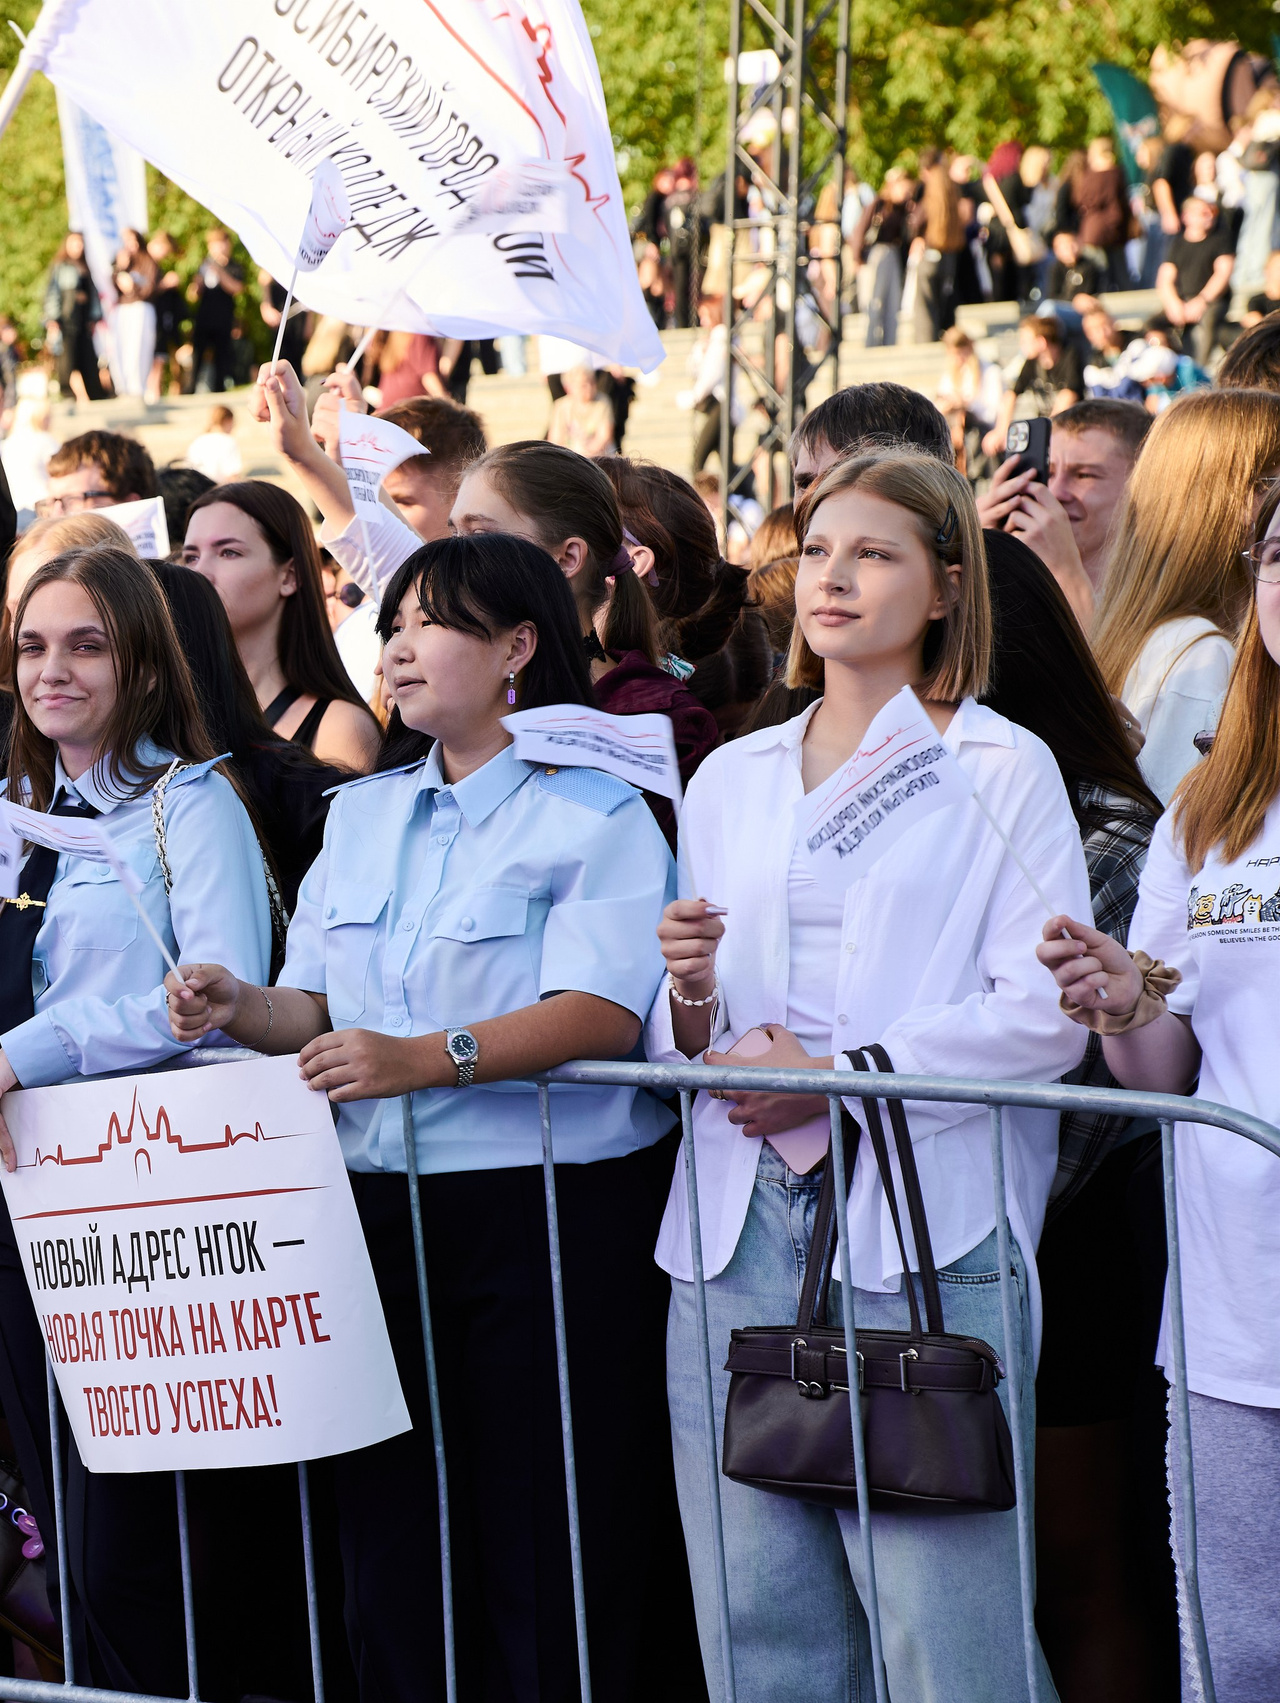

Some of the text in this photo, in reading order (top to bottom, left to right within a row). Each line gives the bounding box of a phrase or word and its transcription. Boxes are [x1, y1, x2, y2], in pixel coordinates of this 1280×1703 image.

[217, 36, 363, 170] ОТКРЫТЫЙ
[1246, 857, 1280, 867] HAP
[1219, 936, 1246, 944] BELIEVES
[1239, 927, 1261, 935] SMILES
[30, 1222, 105, 1290] НОВЫЙ
[112, 1227, 191, 1293] АДРЕС
[195, 1220, 266, 1277] НГОК
[42, 1291, 331, 1364] НОВАЯ ТОЧКА НА КАРТЕ
[83, 1374, 282, 1437] ТВОЕГО УСПЕХА!
